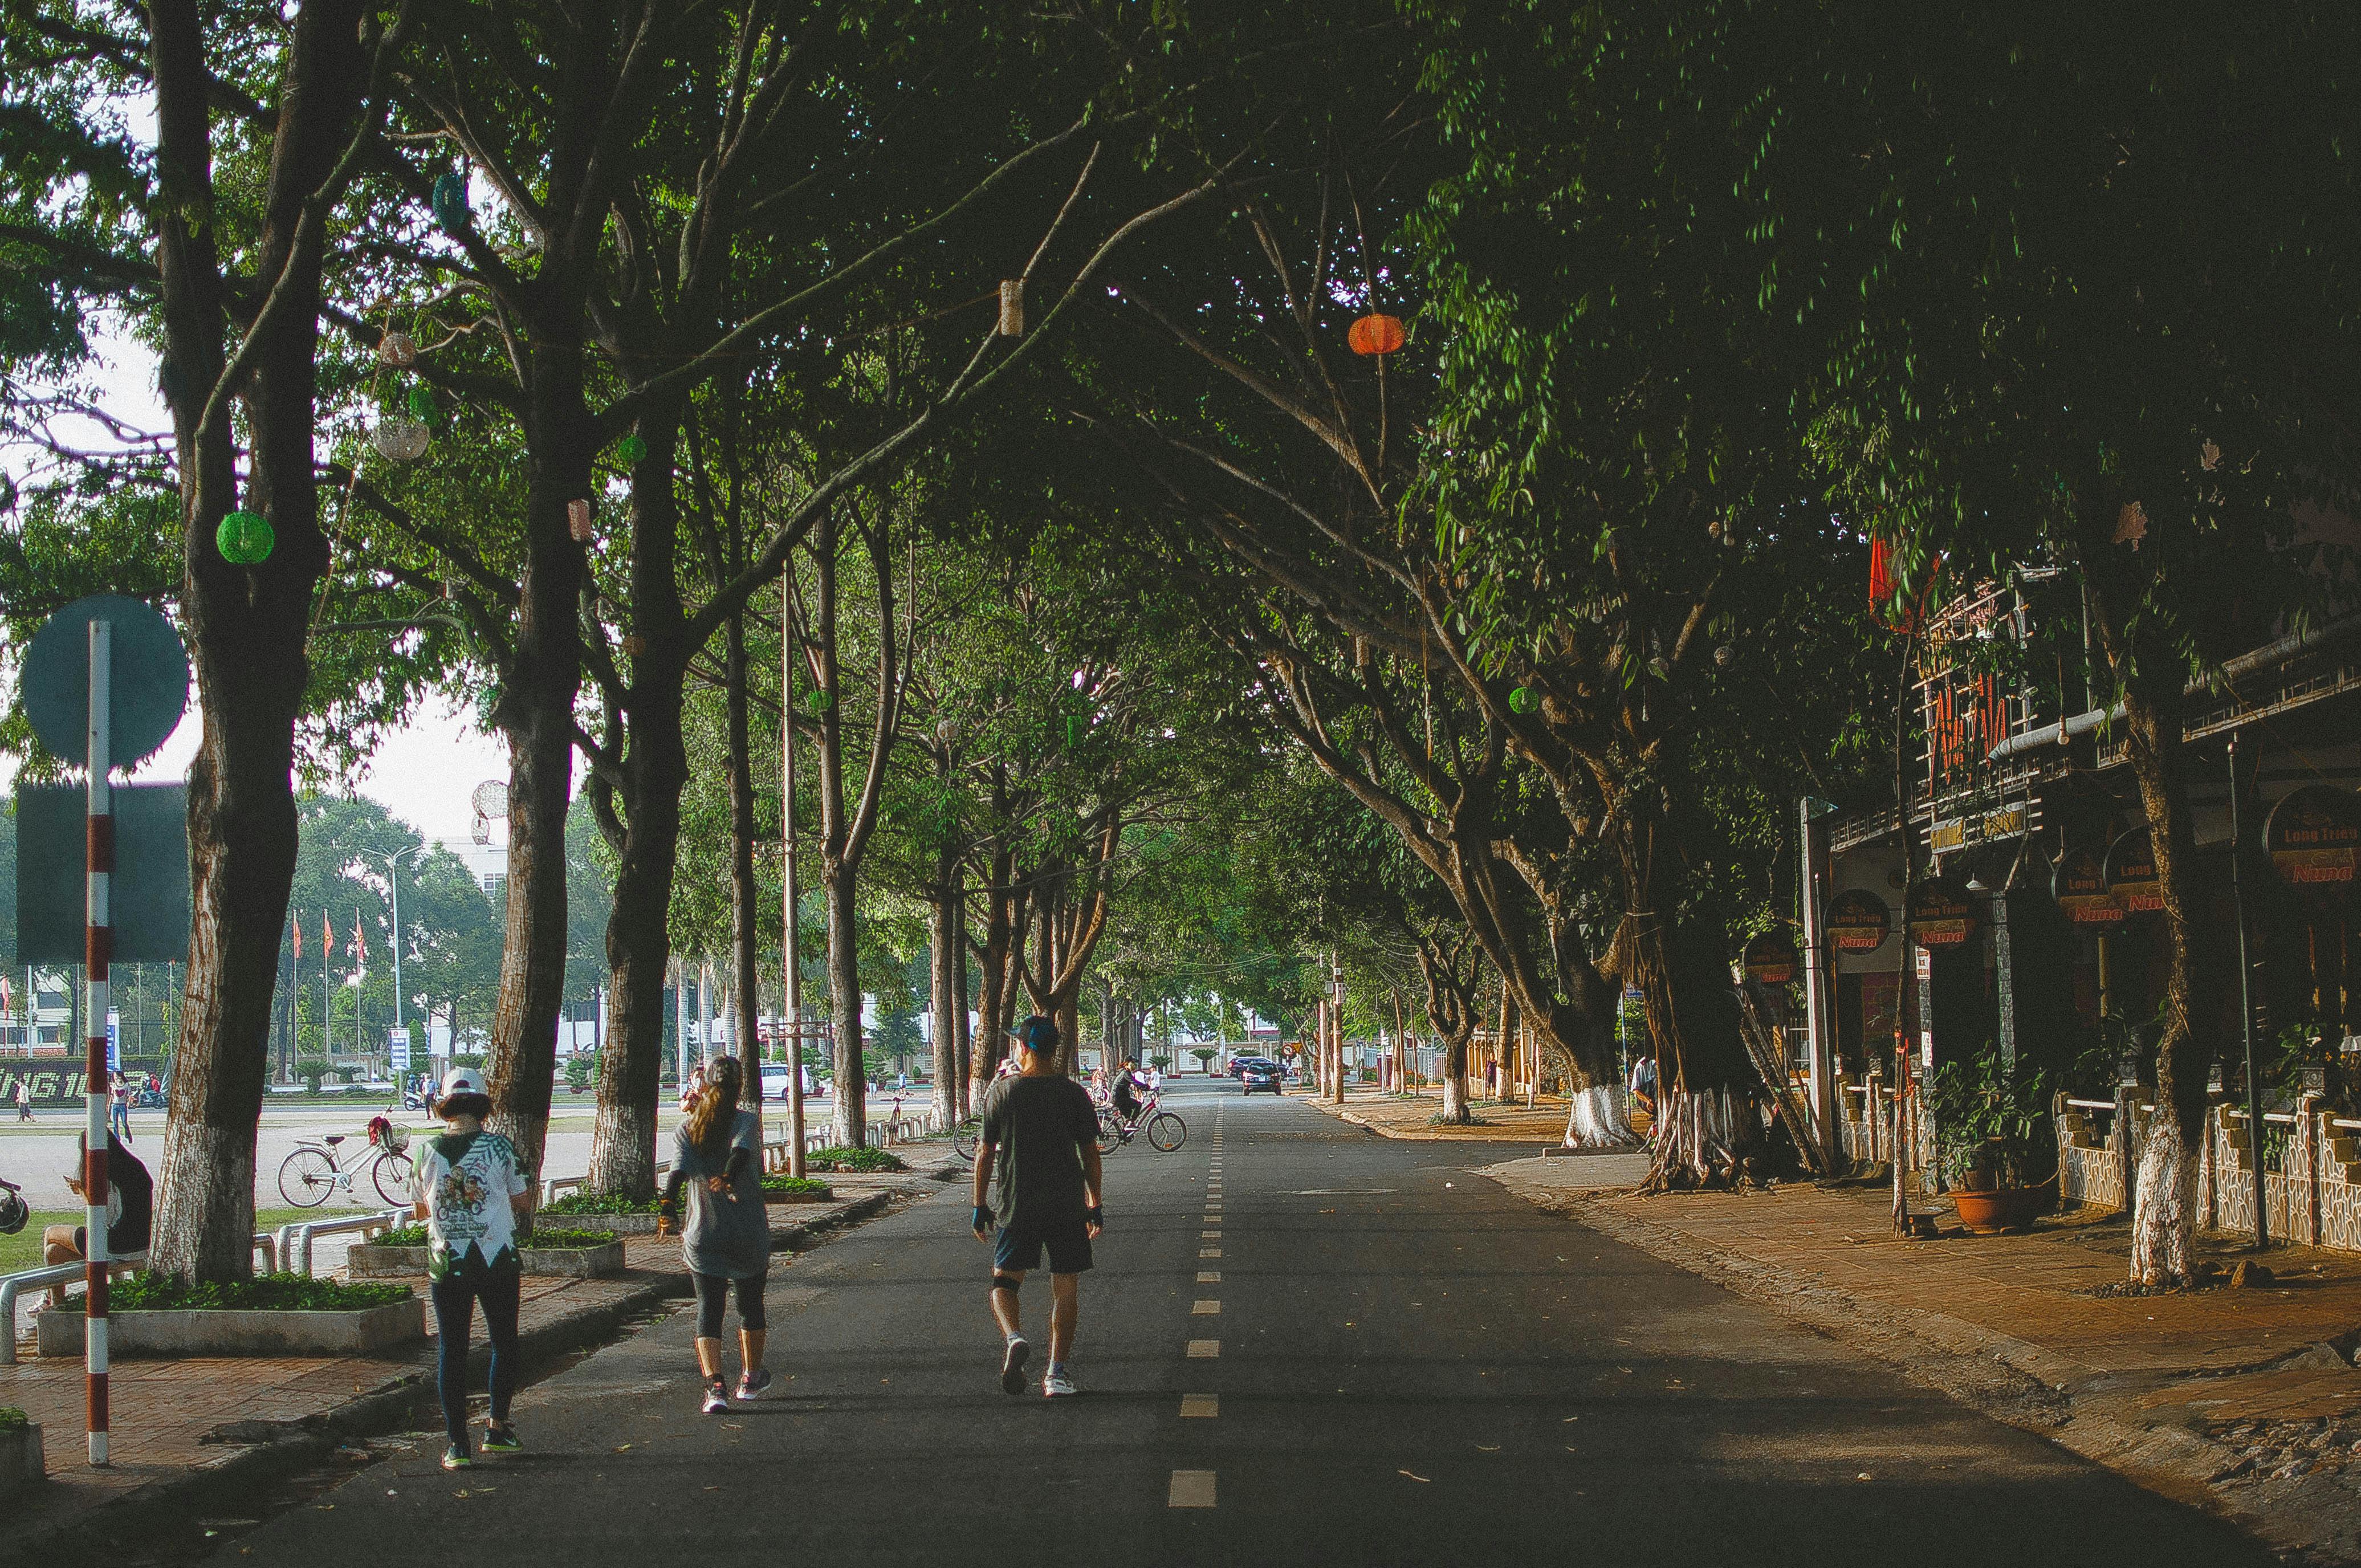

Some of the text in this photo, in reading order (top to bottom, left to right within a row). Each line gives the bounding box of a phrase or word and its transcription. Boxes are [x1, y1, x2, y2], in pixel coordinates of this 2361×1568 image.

[2285, 829, 2318, 842] Long
[2293, 865, 2353, 883] Nuna
[2129, 894, 2163, 911] Nu
[1838, 936, 1877, 948] Nuna
[1921, 930, 1964, 944] Nuna
